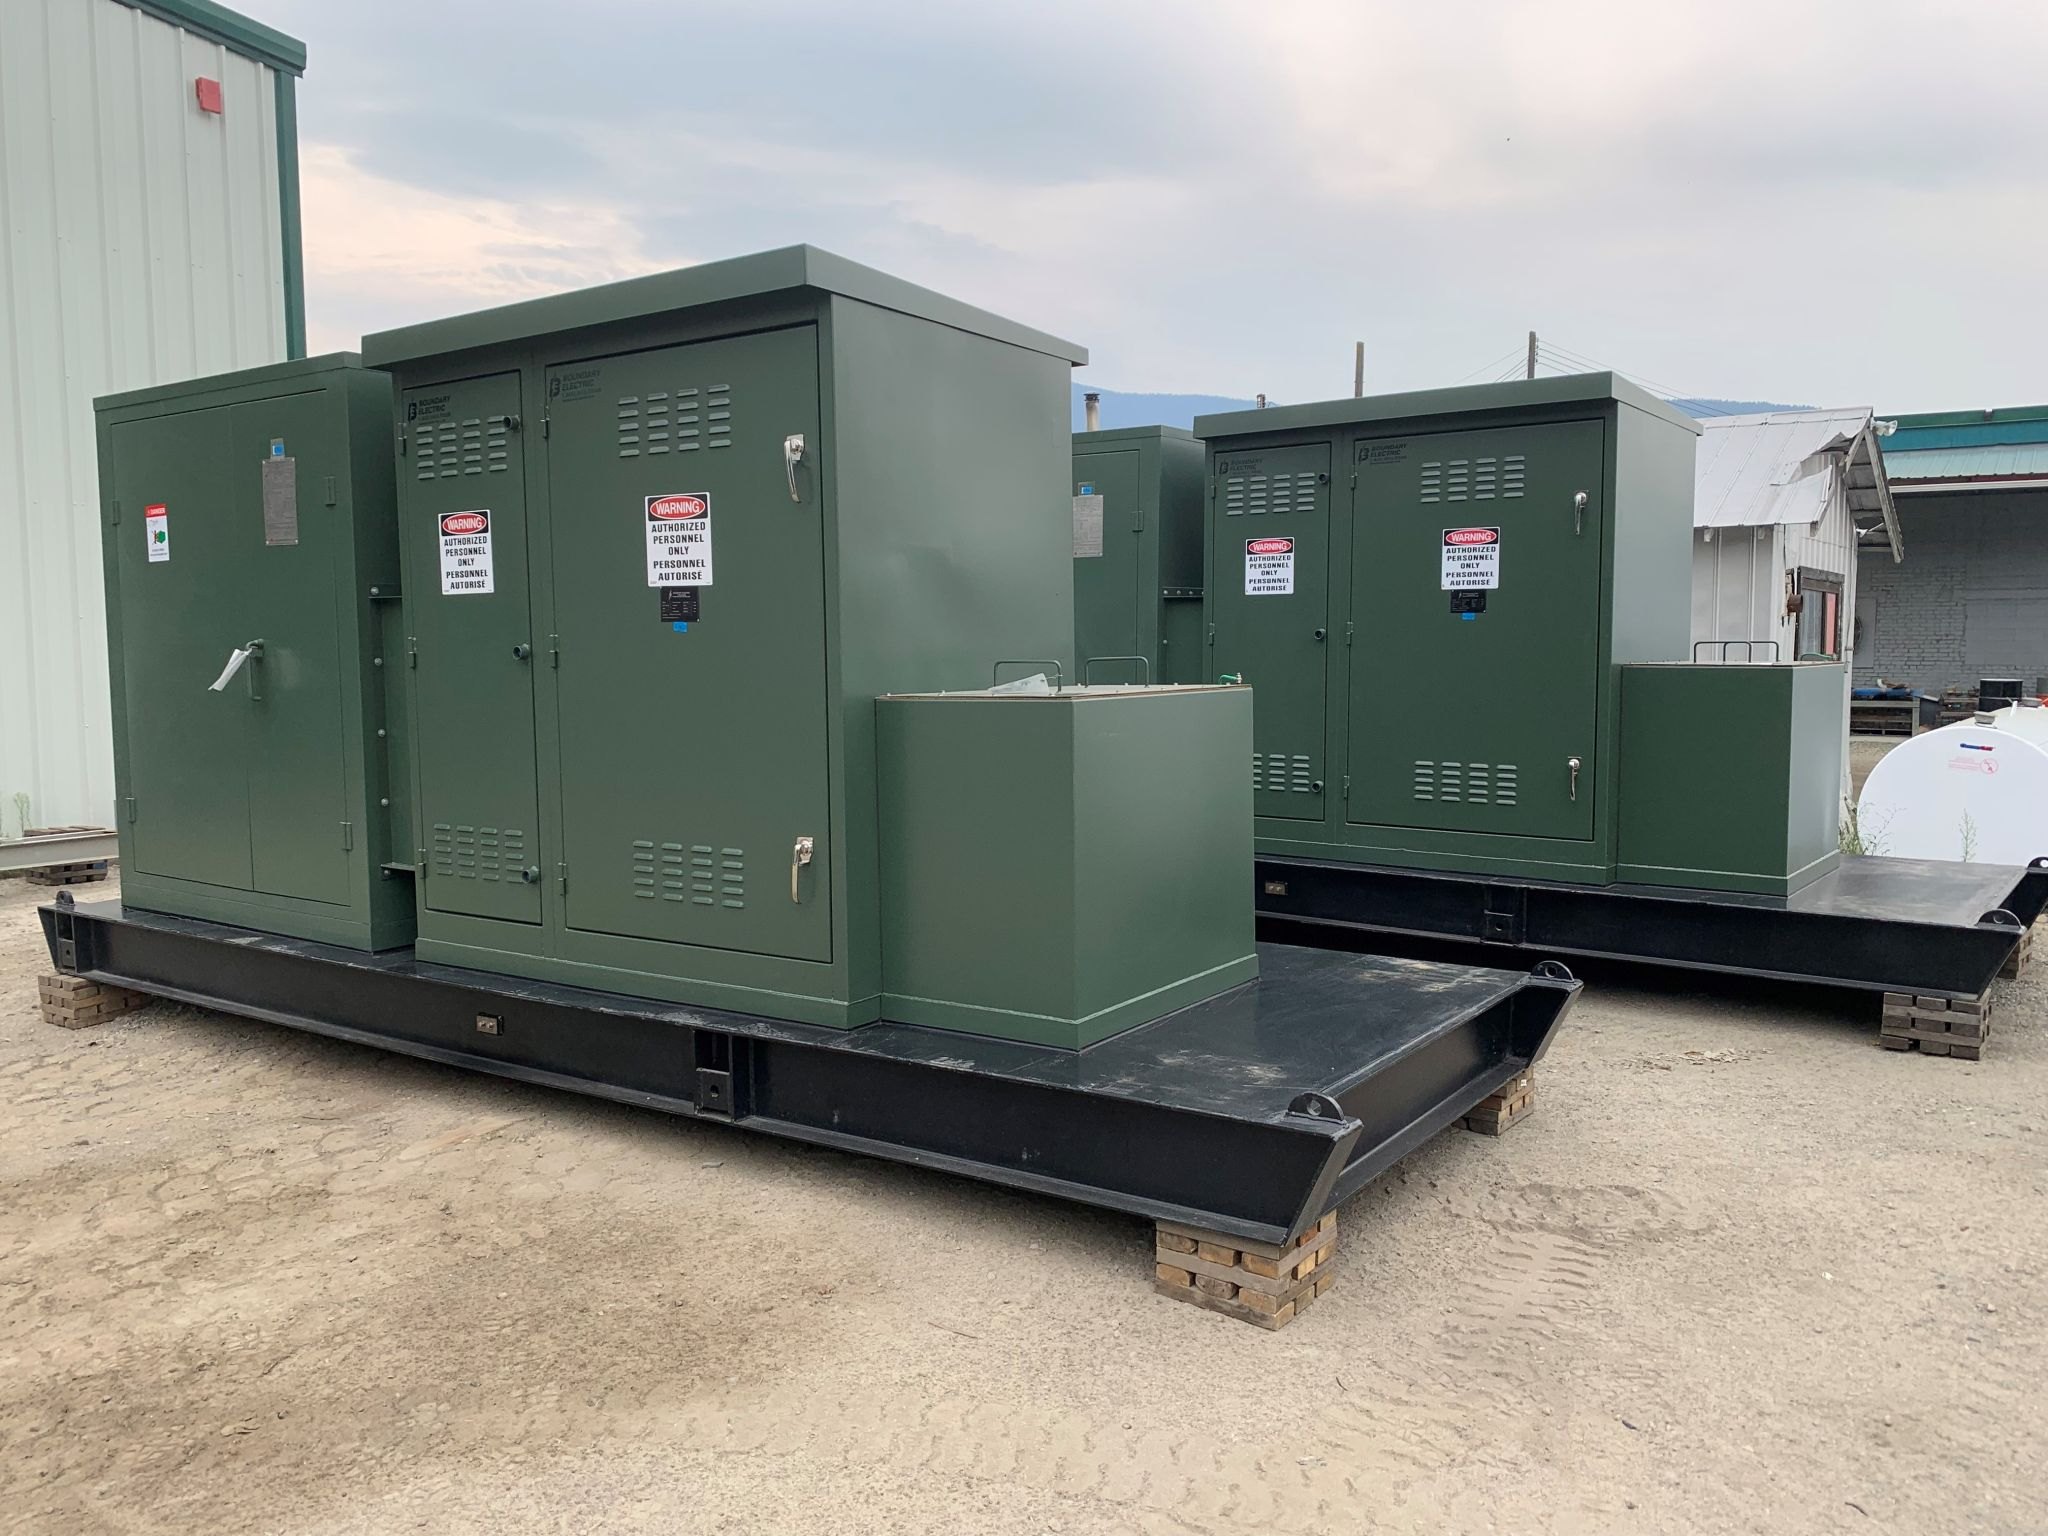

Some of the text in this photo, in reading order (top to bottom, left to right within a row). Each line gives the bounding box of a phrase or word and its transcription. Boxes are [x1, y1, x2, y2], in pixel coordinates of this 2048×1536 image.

[418, 404, 446, 415] ELECTRIC
[656, 501, 700, 515] WARNING
[447, 517, 482, 531] WARNING
[651, 522, 706, 532] AUTHORIZED
[444, 536, 487, 546] AUTHORIZED
[653, 534, 705, 544] PERSONNEL
[1451, 532, 1492, 542] WARNING
[668, 546, 690, 555] ONLY
[1253, 542, 1287, 551] WARNING
[1446, 546, 1496, 554] AUTHORIZED
[445, 547, 487, 557] PERSONNEL
[457, 558, 475, 567] ONLY
[1447, 554, 1494, 562] PERSONNEL
[653, 559, 706, 569] PERSONNEL
[446, 569, 489, 579] PERSONNEL
